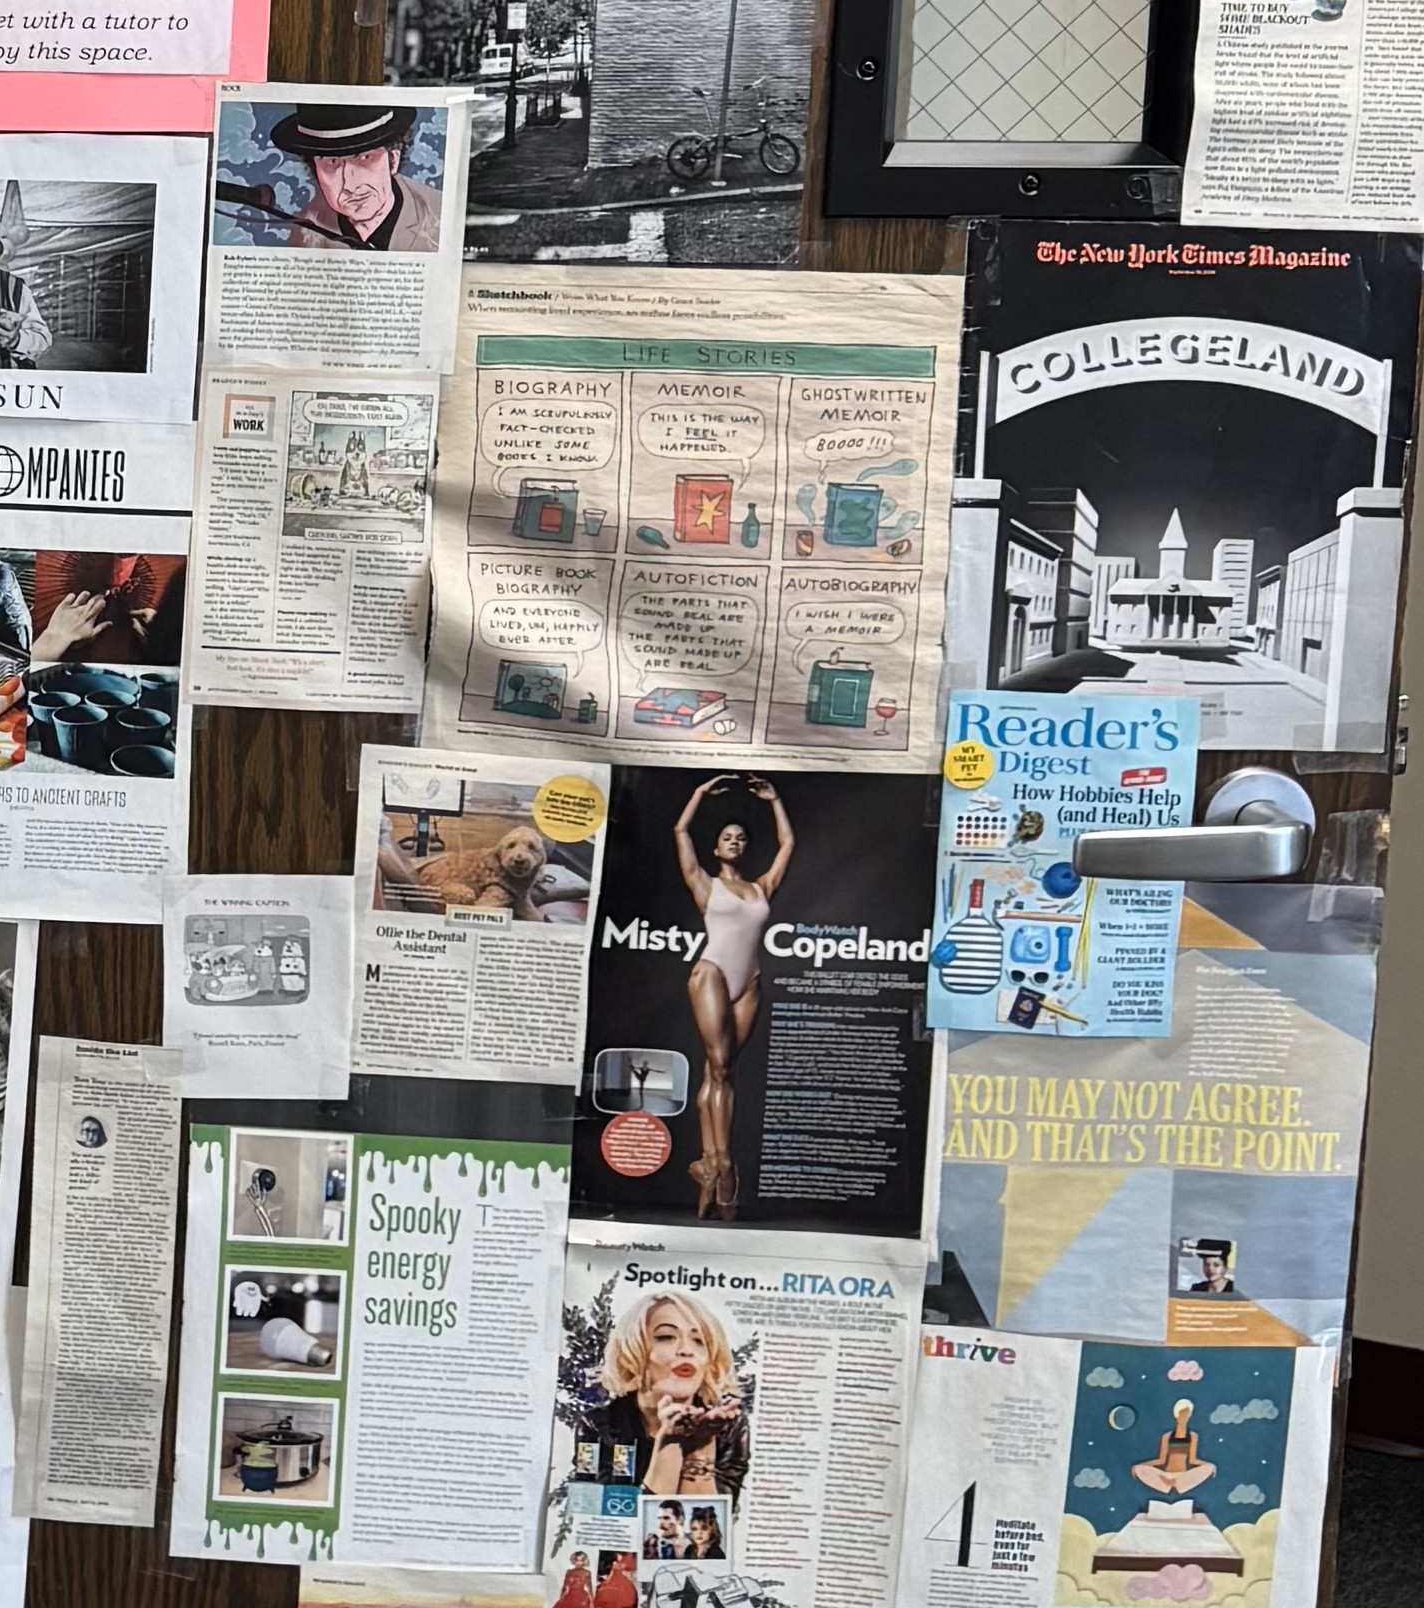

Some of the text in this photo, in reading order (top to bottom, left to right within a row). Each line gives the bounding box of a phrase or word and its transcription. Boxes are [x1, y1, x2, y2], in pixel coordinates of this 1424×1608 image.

[23, 11, 76, 30] with
[82, 16, 97, 30] a
[105, 12, 162, 30] tutor
[168, 13, 189, 31] to
[27, 41, 72, 62] this
[79, 44, 152, 65] space.
[1037, 241, 1351, 270] The New York Times Magazine
[623, 346, 797, 367] LIFE STORIES
[1009, 331, 1366, 397] COLLEGELAND
[494, 381, 613, 398] BIOGRAPHY
[657, 384, 747, 398] MEMOIR
[801, 388, 927, 405] GHOSTWRITTEN
[233, 419, 264, 432] WORK
[820, 409, 901, 422] MEMOIR
[480, 563, 597, 579] PICTURE BOOK
[633, 571, 758, 589] AUTOFICTION
[496, 582, 583, 595] BIOGRAPHY
[785, 578, 920, 594] AUTOBIOGRAPHY
[957, 703, 1179, 752] Reader's
[999, 752, 1091, 781] Digest
[16, 786, 30, 804] TO
[33, 787, 80, 806] ANCIENT
[84, 789, 126, 808] CRAFTS
[1013, 784, 1181, 807] How Hobbies Help
[1057, 806, 1180, 826] (and Heal) Us
[376, 926, 467, 942] Ollie the Dental
[602, 916, 930, 968] Misty Copeland
[393, 941, 447, 954] Assistant
[948, 1074, 1311, 1128] YOU MAY NOT AGREE.
[943, 1119, 1343, 1173] AND THAT'S THE POINT.
[369, 1193, 462, 1245] Spooky
[367, 1247, 451, 1292] energy
[624, 1263, 727, 1293] Spotlight
[782, 1272, 836, 1295] RITA
[838, 1277, 895, 1300] ORA
[363, 1292, 458, 1337] savings
[922, 1334, 1017, 1365] thrive
